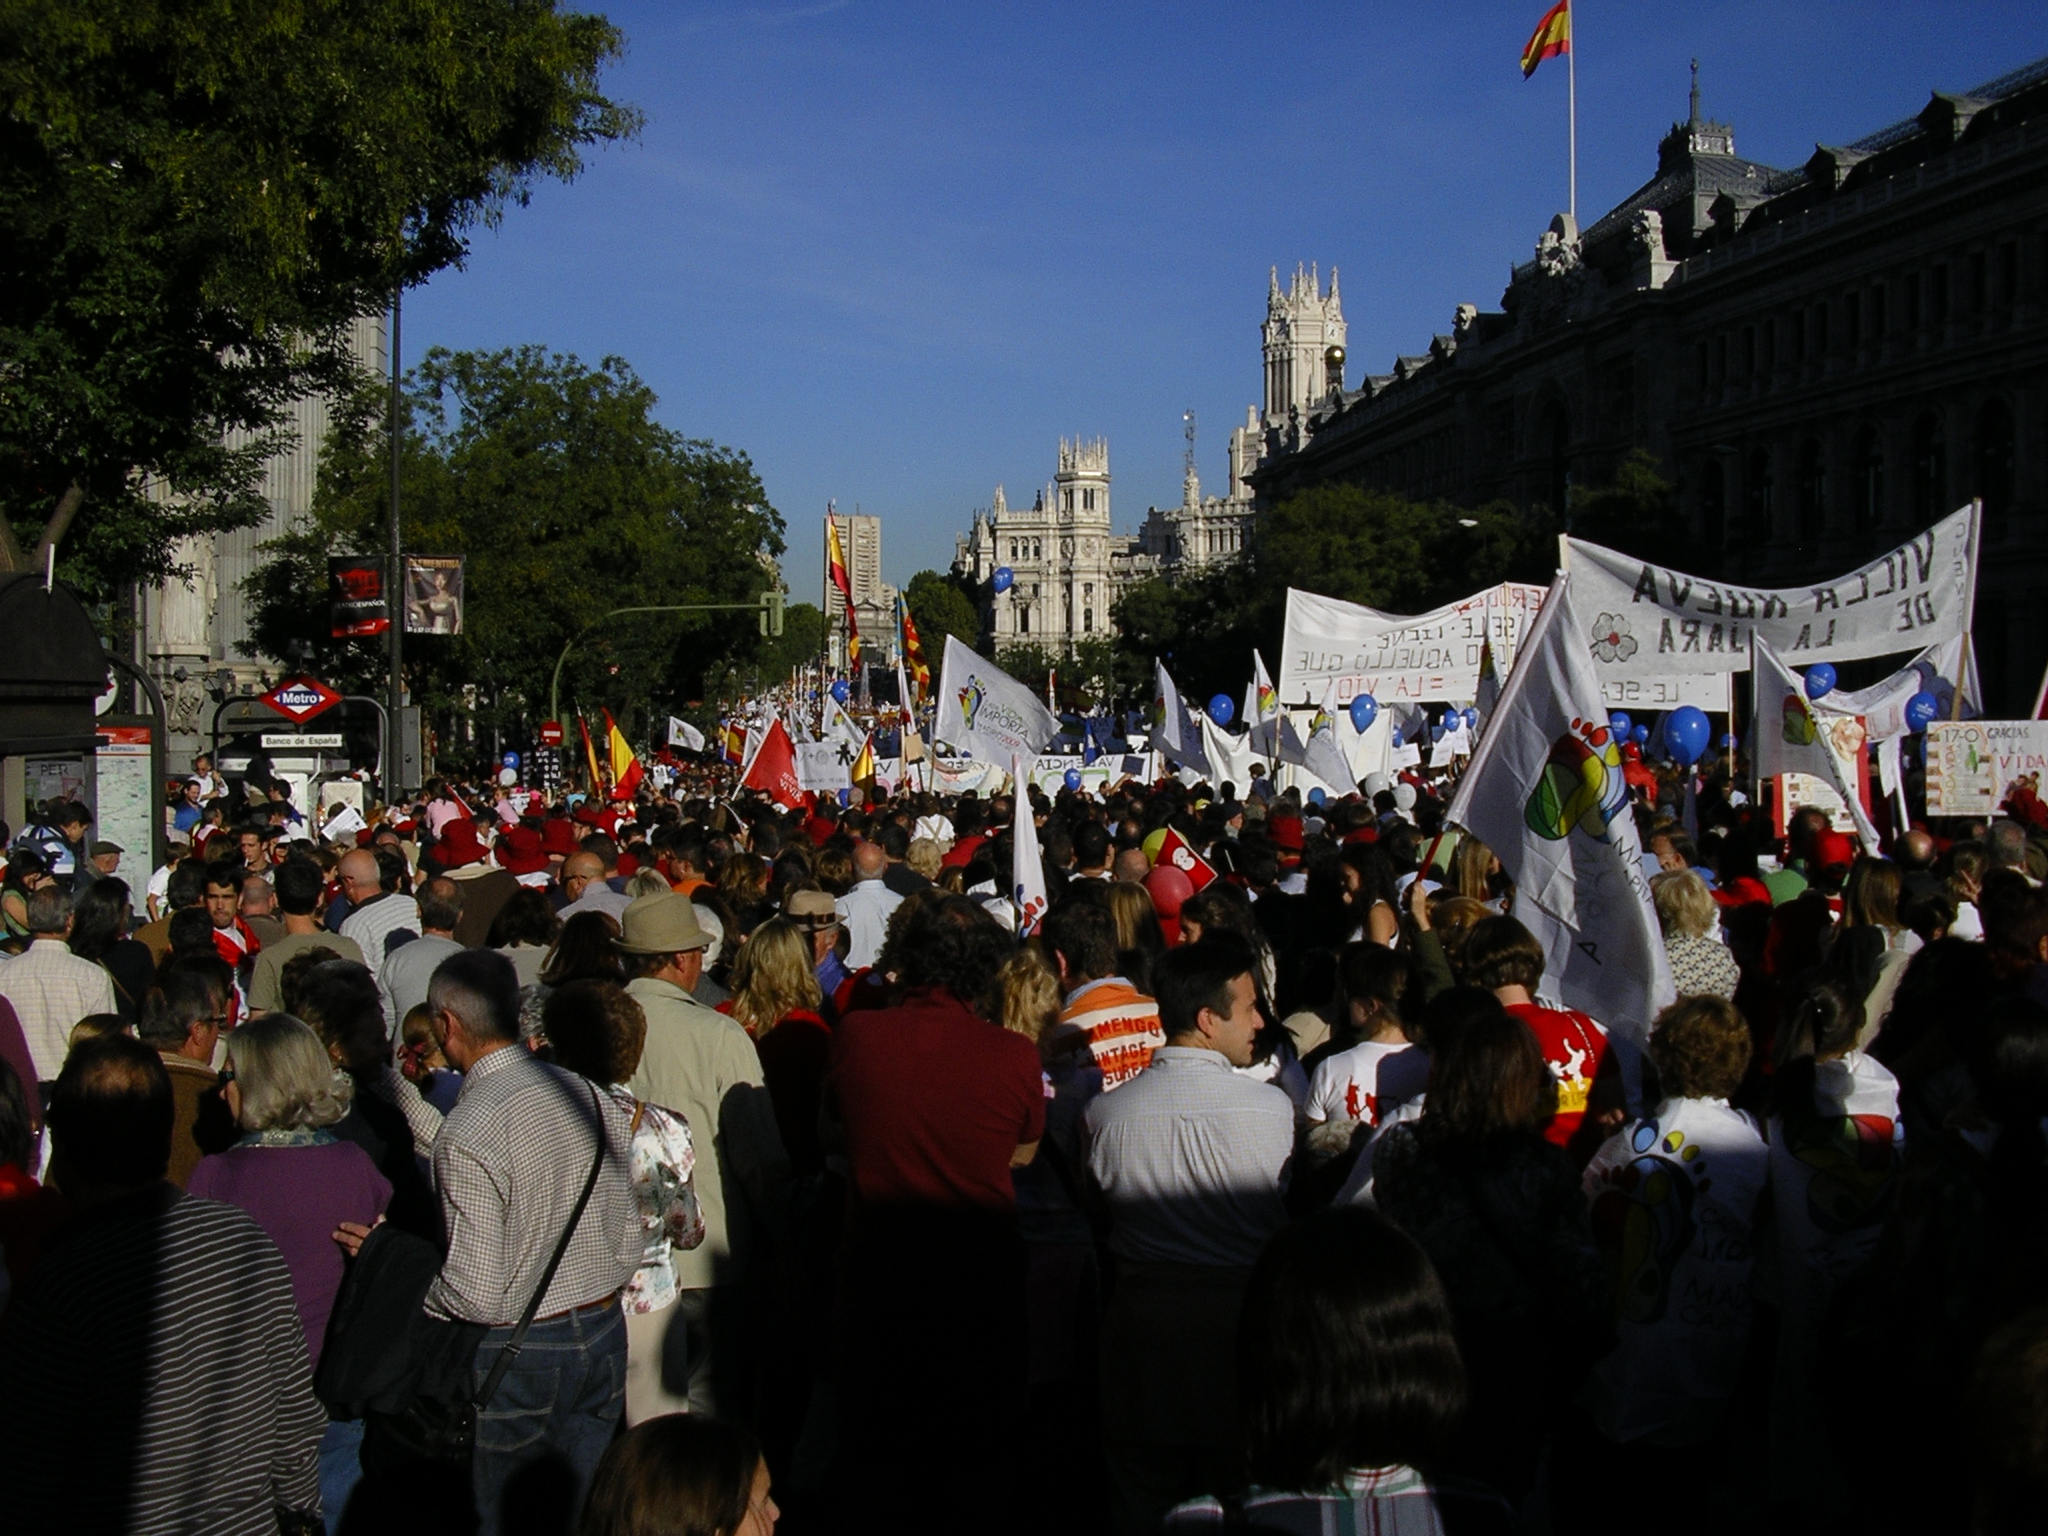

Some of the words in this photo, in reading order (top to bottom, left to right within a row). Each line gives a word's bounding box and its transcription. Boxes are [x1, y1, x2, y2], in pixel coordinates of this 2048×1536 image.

[282, 693, 317, 704] Metro
[980, 706, 1028, 738] IMPORTA
[266, 737, 292, 745] Banco
[295, 737, 305, 745] de
[309, 737, 338, 748] España
[2000, 753, 2046, 769] VIDA
